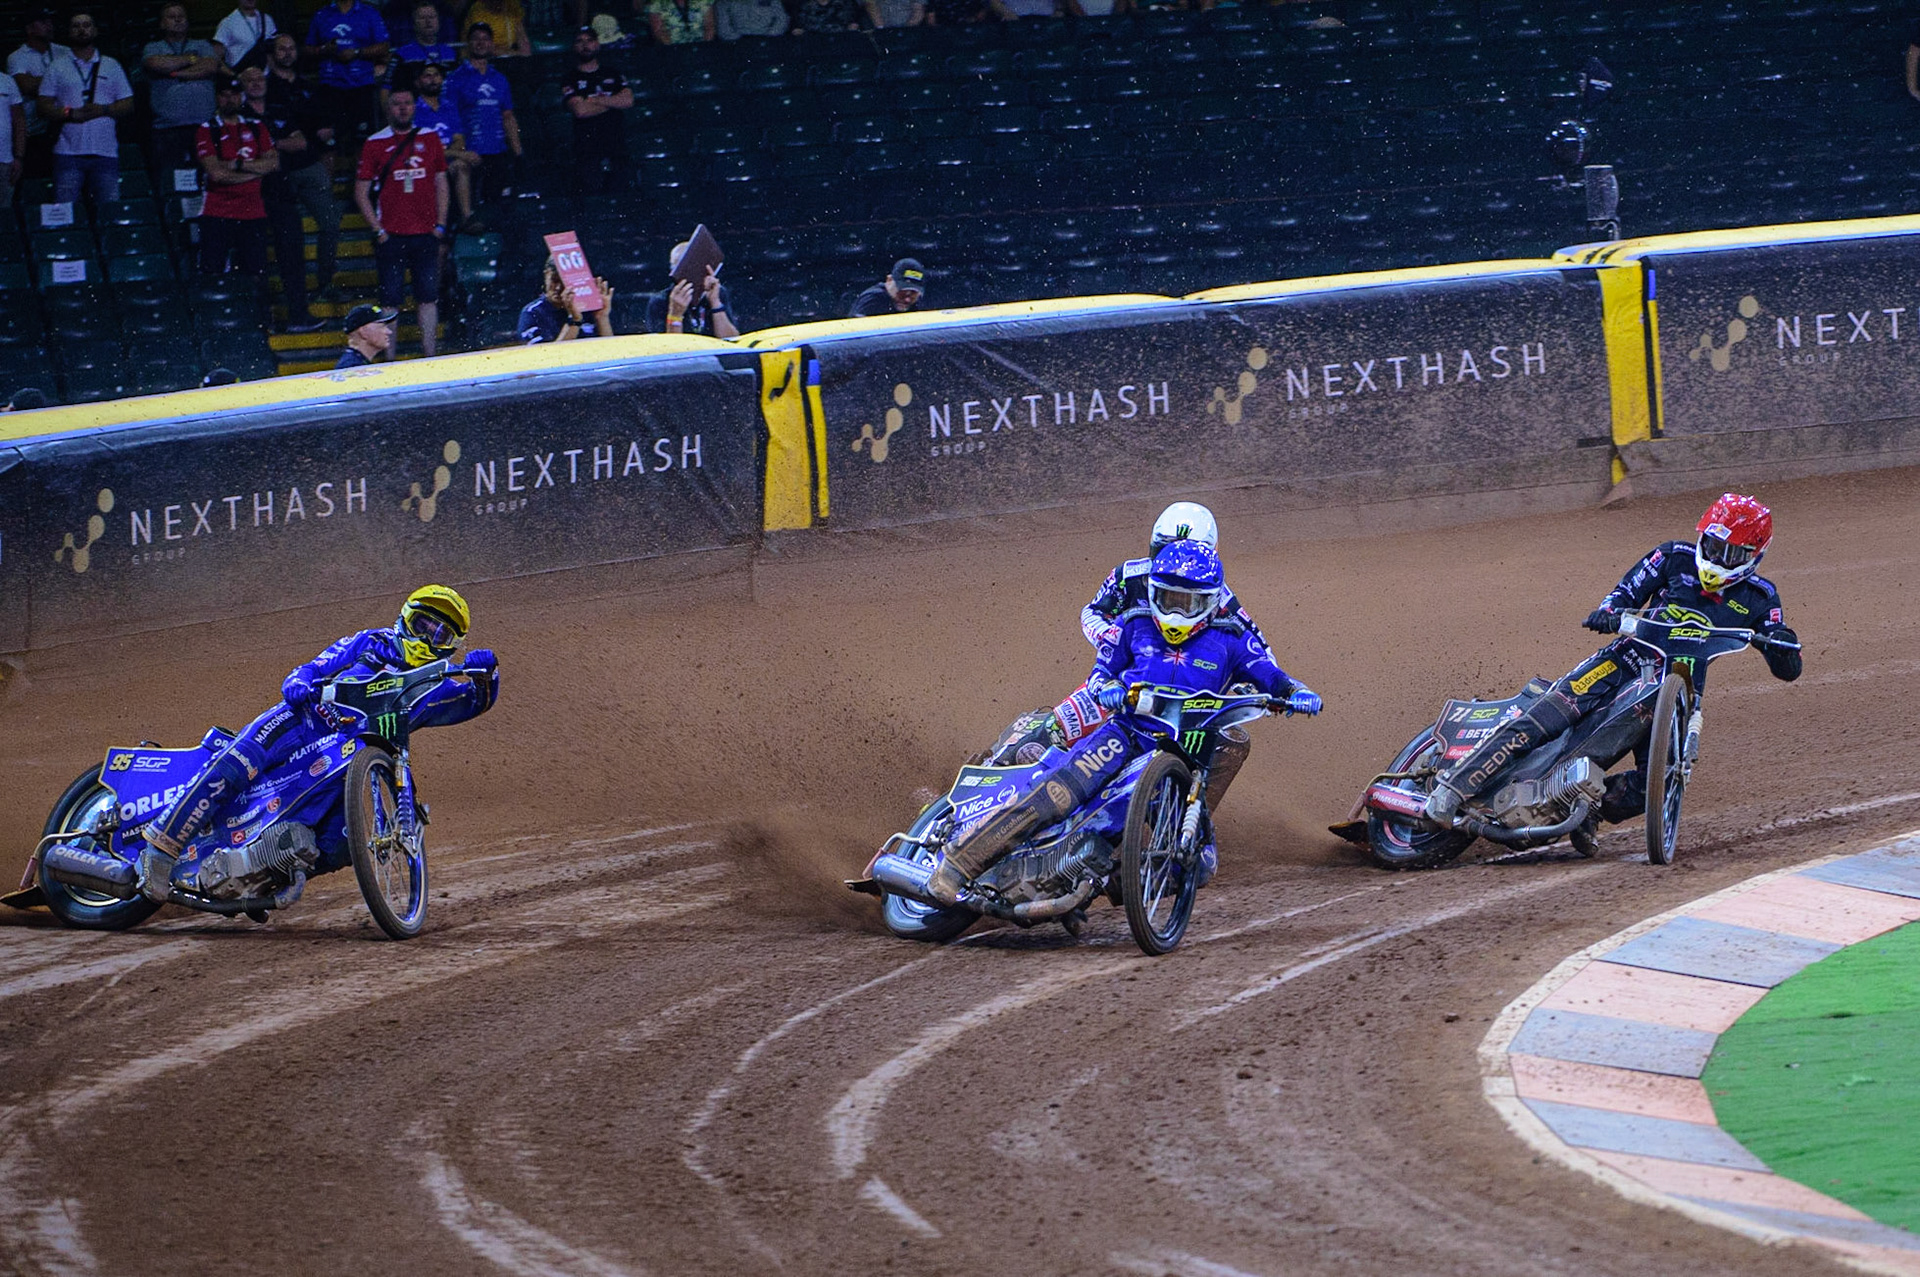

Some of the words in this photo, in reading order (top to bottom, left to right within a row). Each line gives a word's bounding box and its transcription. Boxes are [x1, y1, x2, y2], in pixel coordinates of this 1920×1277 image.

[1777, 307, 1920, 349] NEXT
[1286, 342, 1546, 401] NEXTHASH
[928, 381, 1170, 438] NEXTHASH
[474, 434, 702, 497] NEXTHASH
[131, 477, 367, 546] NEXTHASH
[1727, 600, 1750, 615] SGP
[1669, 628, 1700, 638] SGP
[1192, 659, 1218, 671] SGP
[366, 679, 397, 694] SGP
[1573, 662, 1616, 694] 123drukuj.pl
[1182, 699, 1215, 709] SGP
[1448, 706, 1473, 722] 71
[1470, 708, 1500, 719] SGP
[340, 738, 356, 759] 95
[1075, 738, 1125, 778] Nice
[109, 753, 135, 771] 95
[133, 756, 171, 768] SGP
[120, 784, 185, 822] ORLE
[958, 796, 994, 819] Nice
[176, 798, 210, 843] ORLEN
[55, 847, 100, 865] ORLEN
